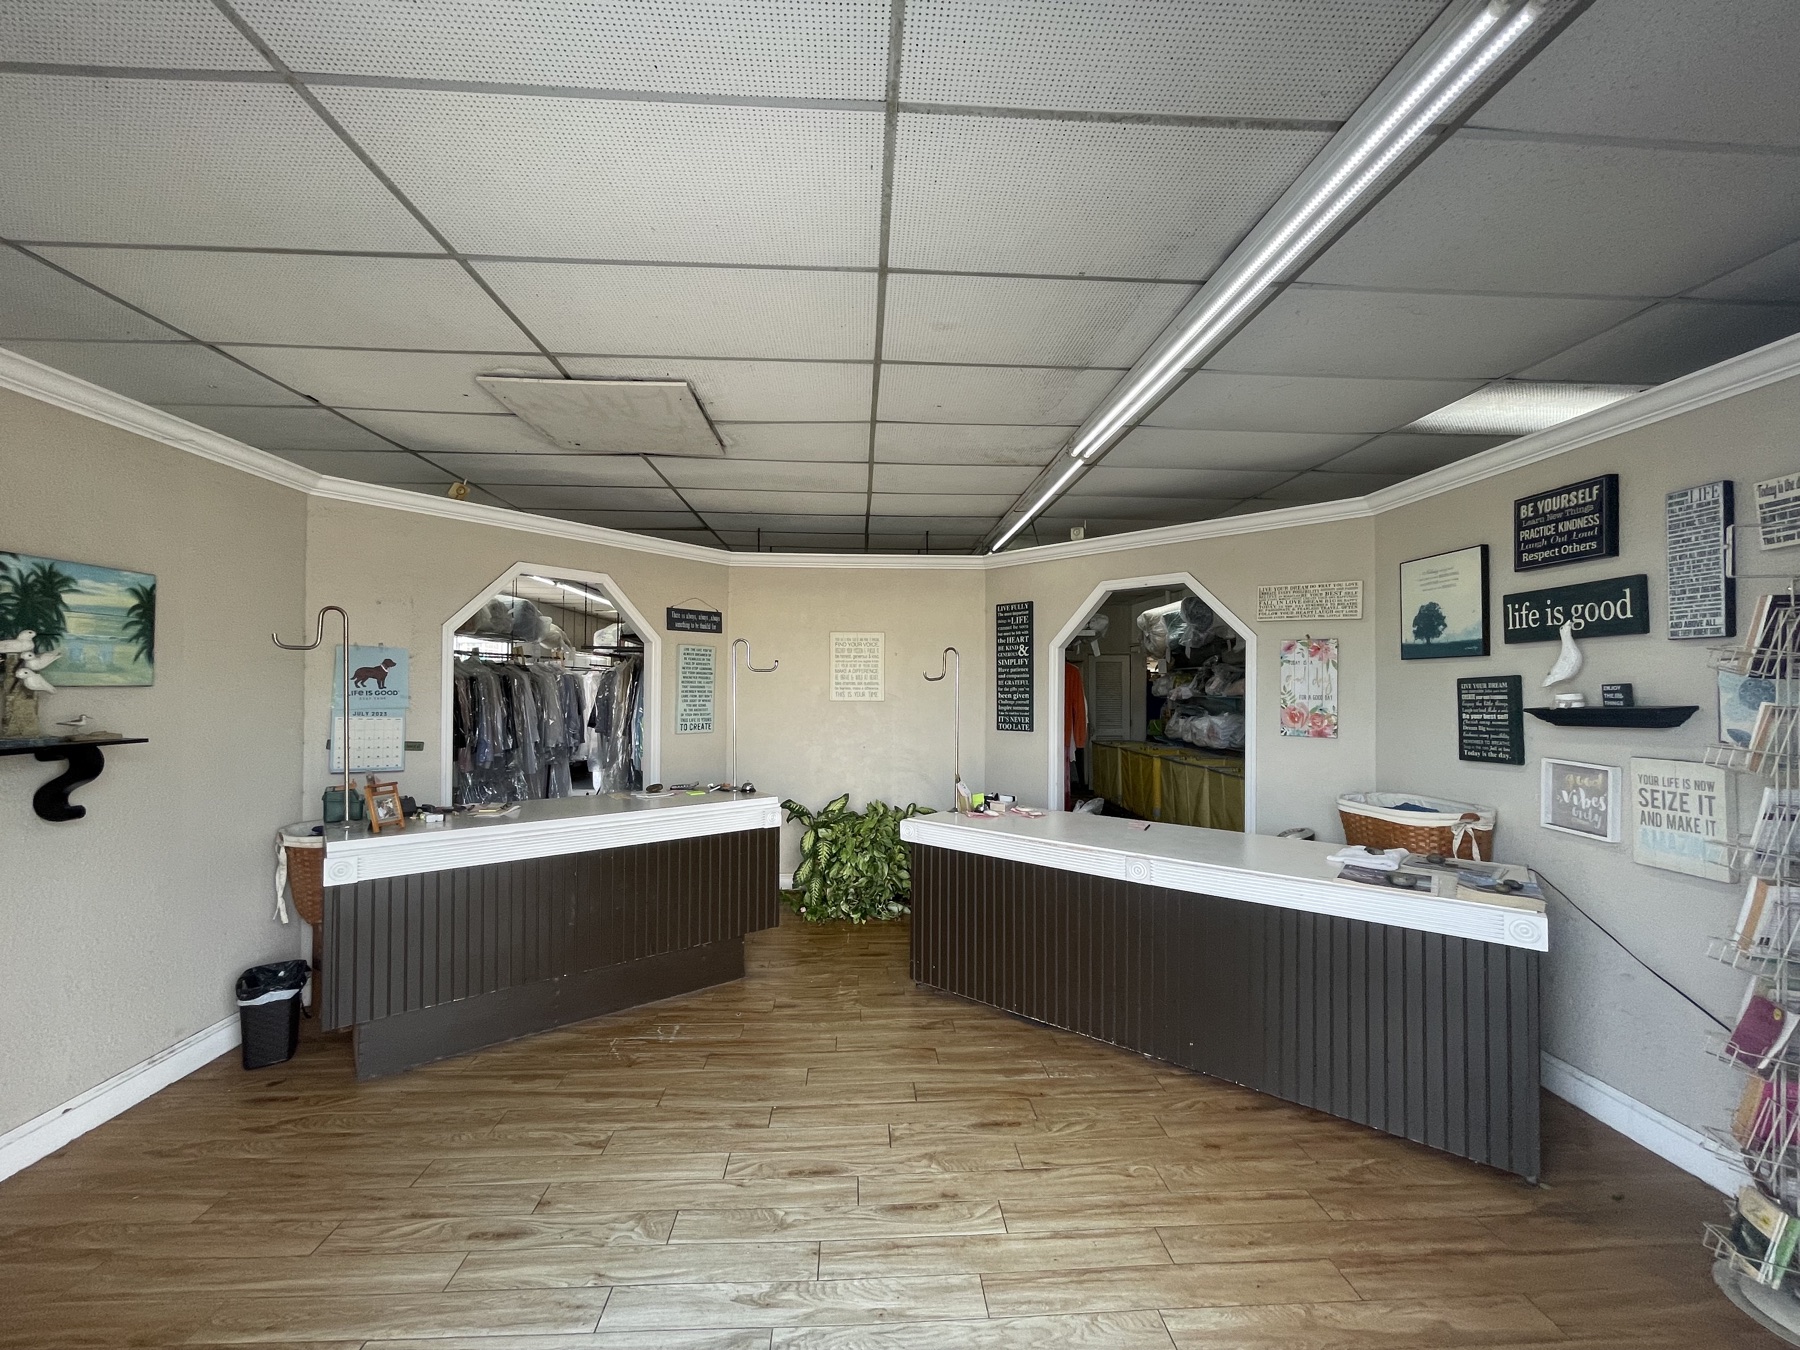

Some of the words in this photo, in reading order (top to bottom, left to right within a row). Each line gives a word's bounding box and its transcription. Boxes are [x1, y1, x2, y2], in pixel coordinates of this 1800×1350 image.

[1520, 503, 1534, 519] BE
[1537, 485, 1600, 515] YOURSELF
[1690, 484, 1720, 503] LIFE
[1522, 517, 1545, 528] Learn
[1547, 511, 1563, 523] New
[1565, 504, 1594, 517] Things
[1520, 523, 1556, 541] PRACTICE
[1558, 513, 1600, 533] KINDNESS
[1521, 538, 1547, 551] Laugh
[1550, 535, 1568, 544] Out
[1572, 527, 1598, 540] Loud
[1522, 548, 1559, 562] Respect
[1561, 541, 1597, 555] Others
[1011, 603, 1028, 611] FULLY
[1507, 601, 1540, 630] life
[1545, 599, 1565, 626] is
[1570, 588, 1633, 631] good
[1011, 615, 1029, 624] LIFE
[1006, 636, 1030, 644] HEART
[1018, 644, 1030, 657] &
[998, 658, 1029, 666] SIMPLIFY
[1013, 692, 1029, 700] given
[689, 723, 712, 731] CREATE
[1464, 750, 1481, 758] Today
[1565, 773, 1604, 788] good
[1637, 773, 1660, 787] YOUR
[1662, 777, 1680, 789] LIFE
[1682, 779, 1691, 790] IS
[1694, 780, 1715, 793] NOW
[1561, 787, 1607, 812] vibes
[1638, 787, 1691, 814] SEIZE
[1698, 795, 1716, 817] IT
[1571, 805, 1603, 829] only
[1640, 810, 1663, 828] AND
[1666, 813, 1702, 834] MAKE
[1705, 820, 1717, 837] IT
